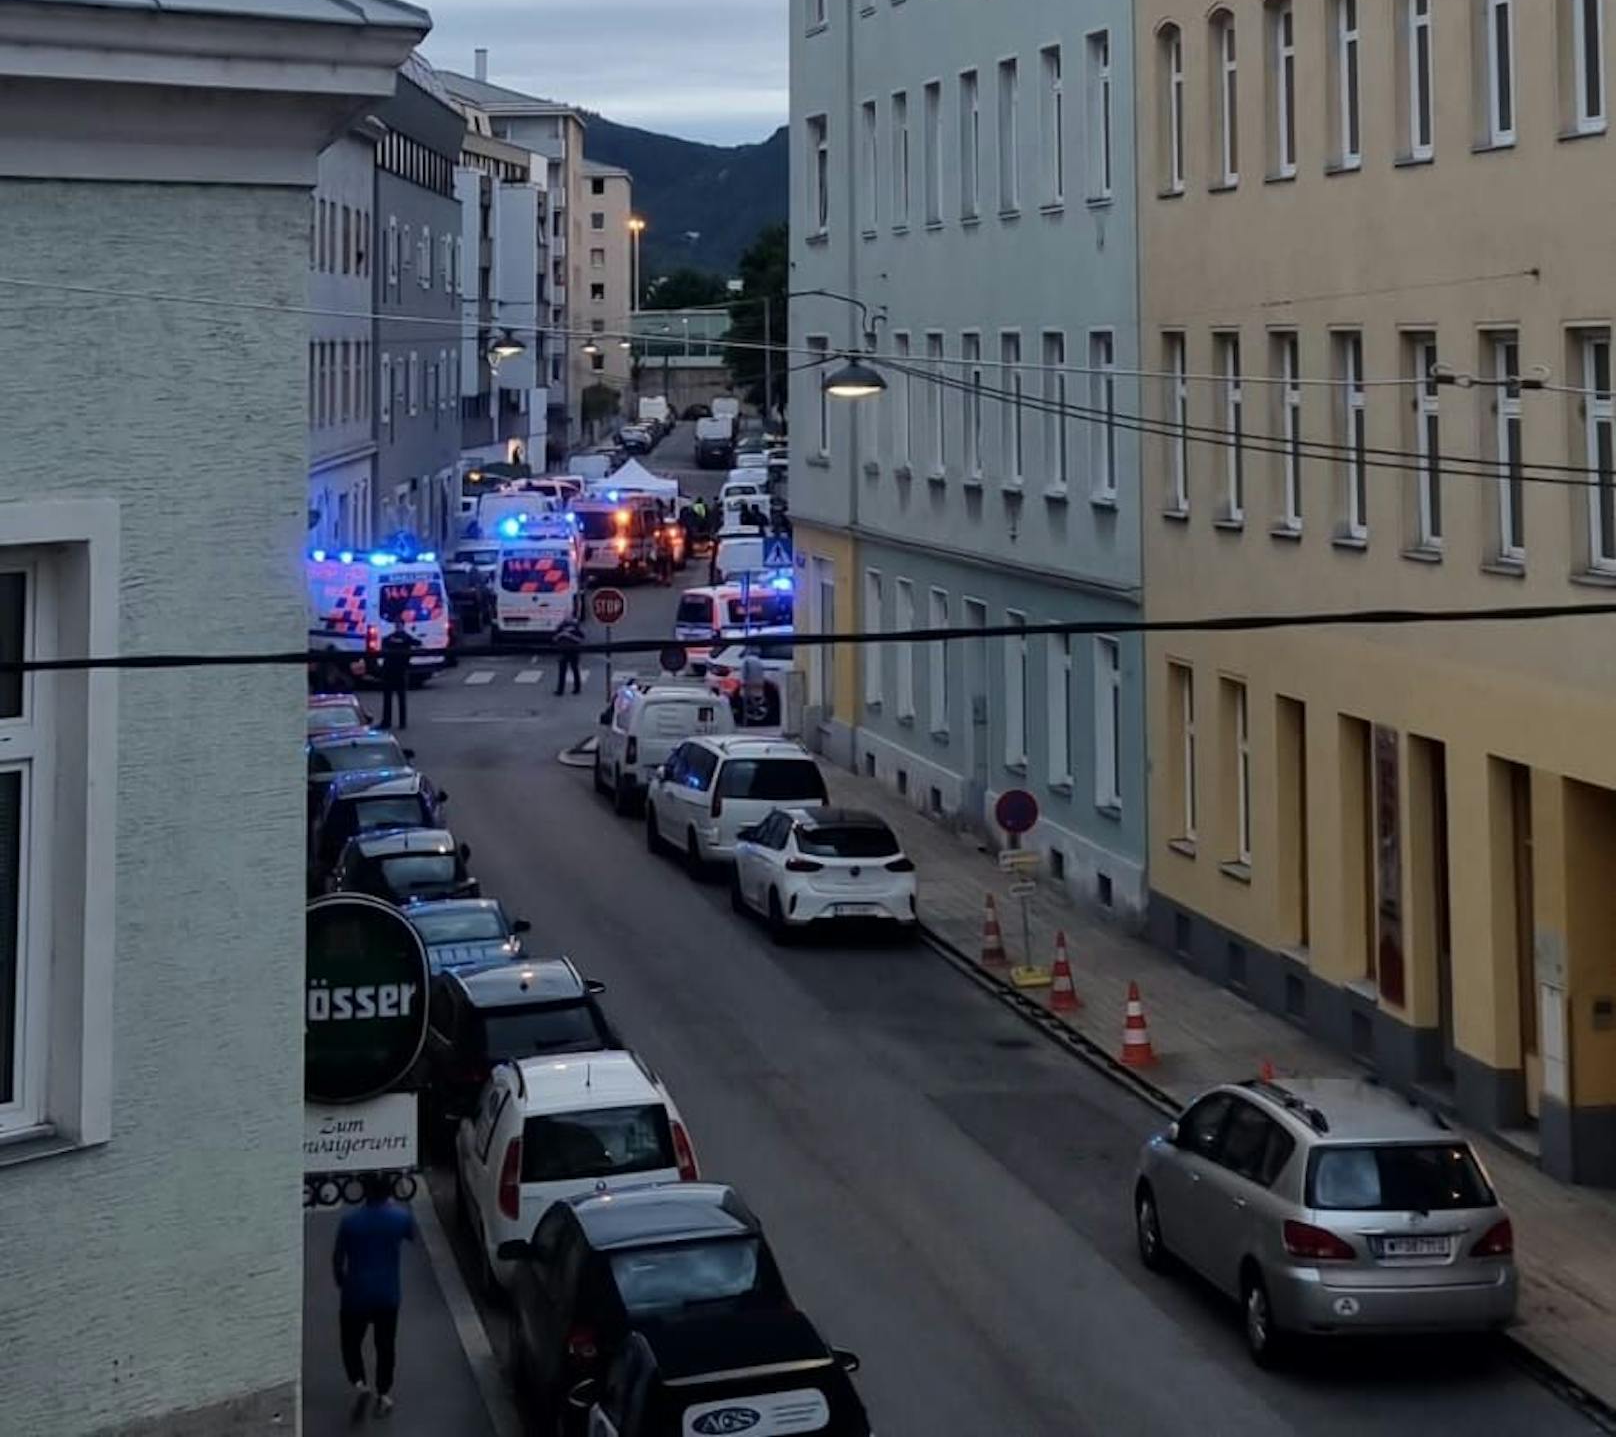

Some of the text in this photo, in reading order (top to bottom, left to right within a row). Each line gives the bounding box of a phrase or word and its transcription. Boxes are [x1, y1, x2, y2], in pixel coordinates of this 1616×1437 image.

[595, 598, 621, 615] STOP
[307, 978, 416, 1021] össer
[319, 1116, 364, 1134] Zum
